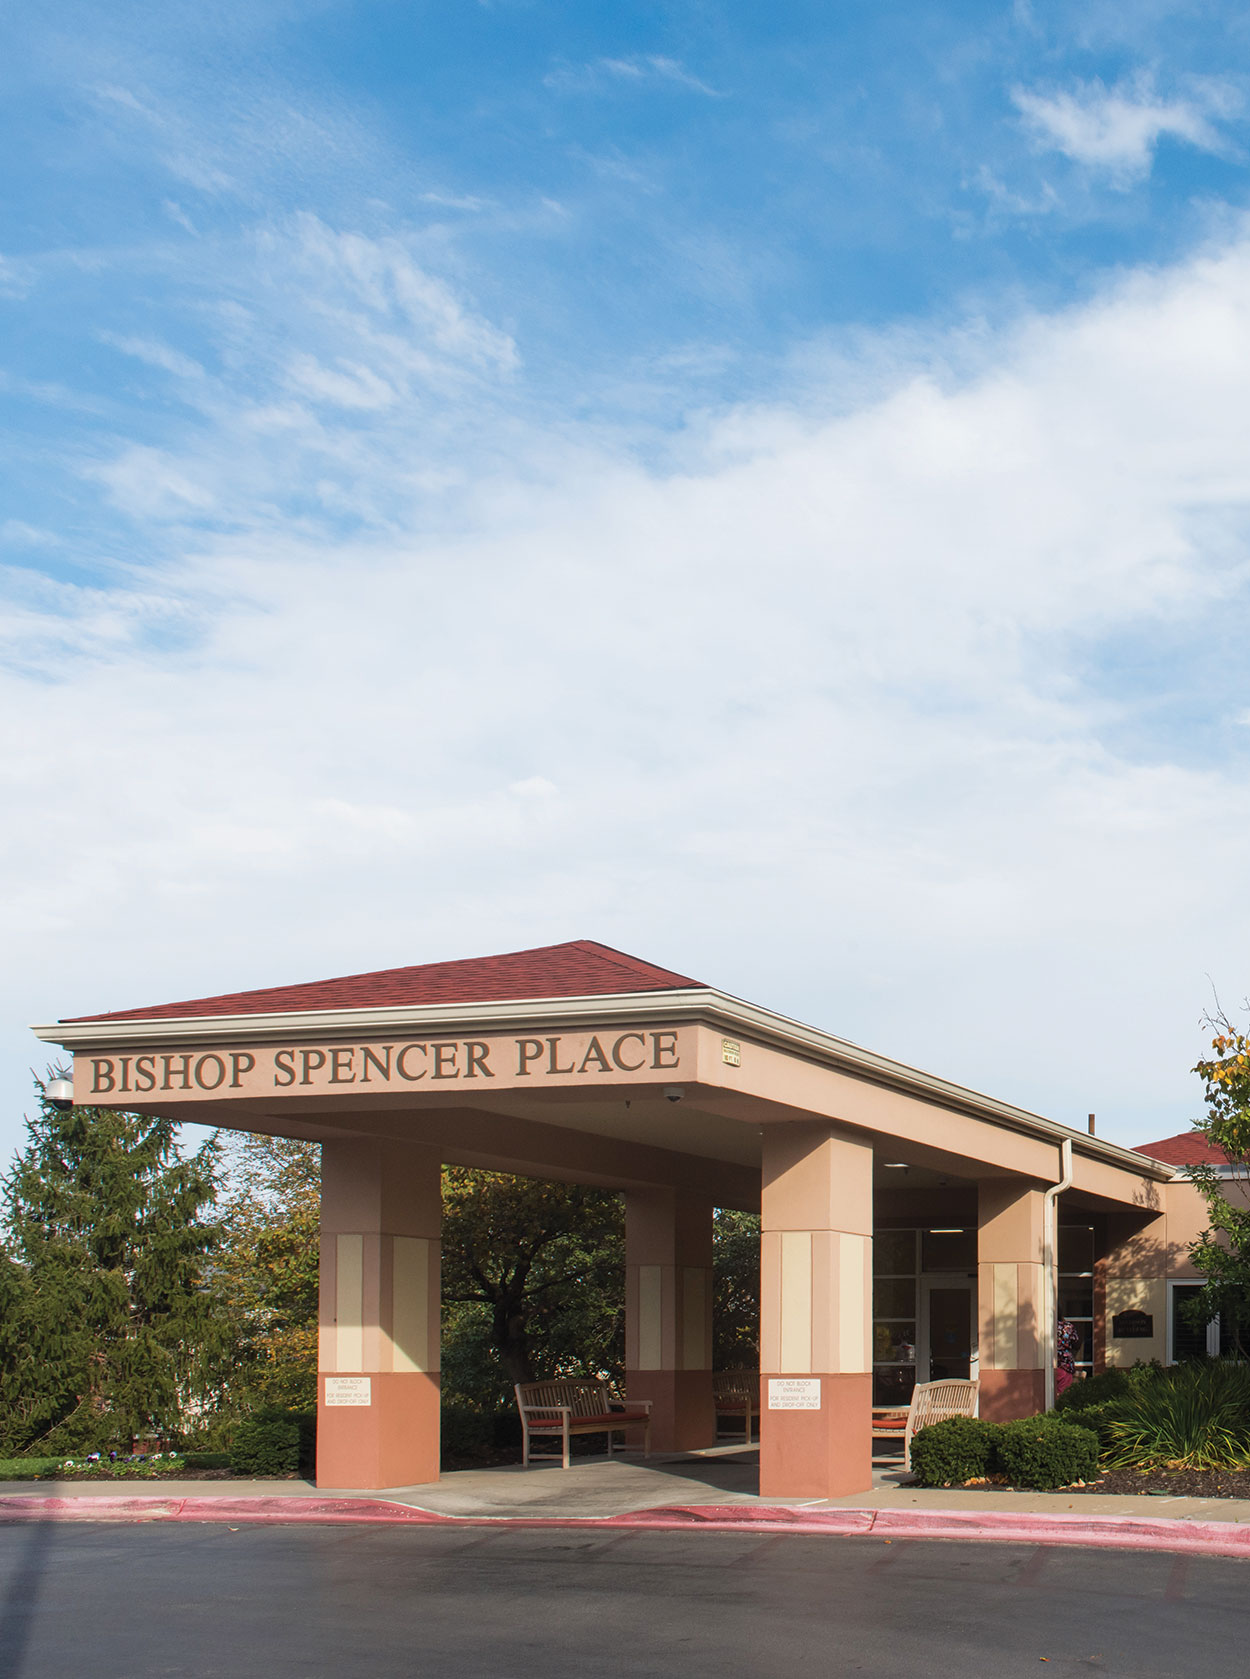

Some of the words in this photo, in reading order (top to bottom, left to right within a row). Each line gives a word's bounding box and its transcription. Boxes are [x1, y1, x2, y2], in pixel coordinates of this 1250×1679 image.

[90, 1053, 255, 1093] BISHOP
[274, 1041, 495, 1087] SPENCER
[515, 1030, 680, 1076] PLACE
